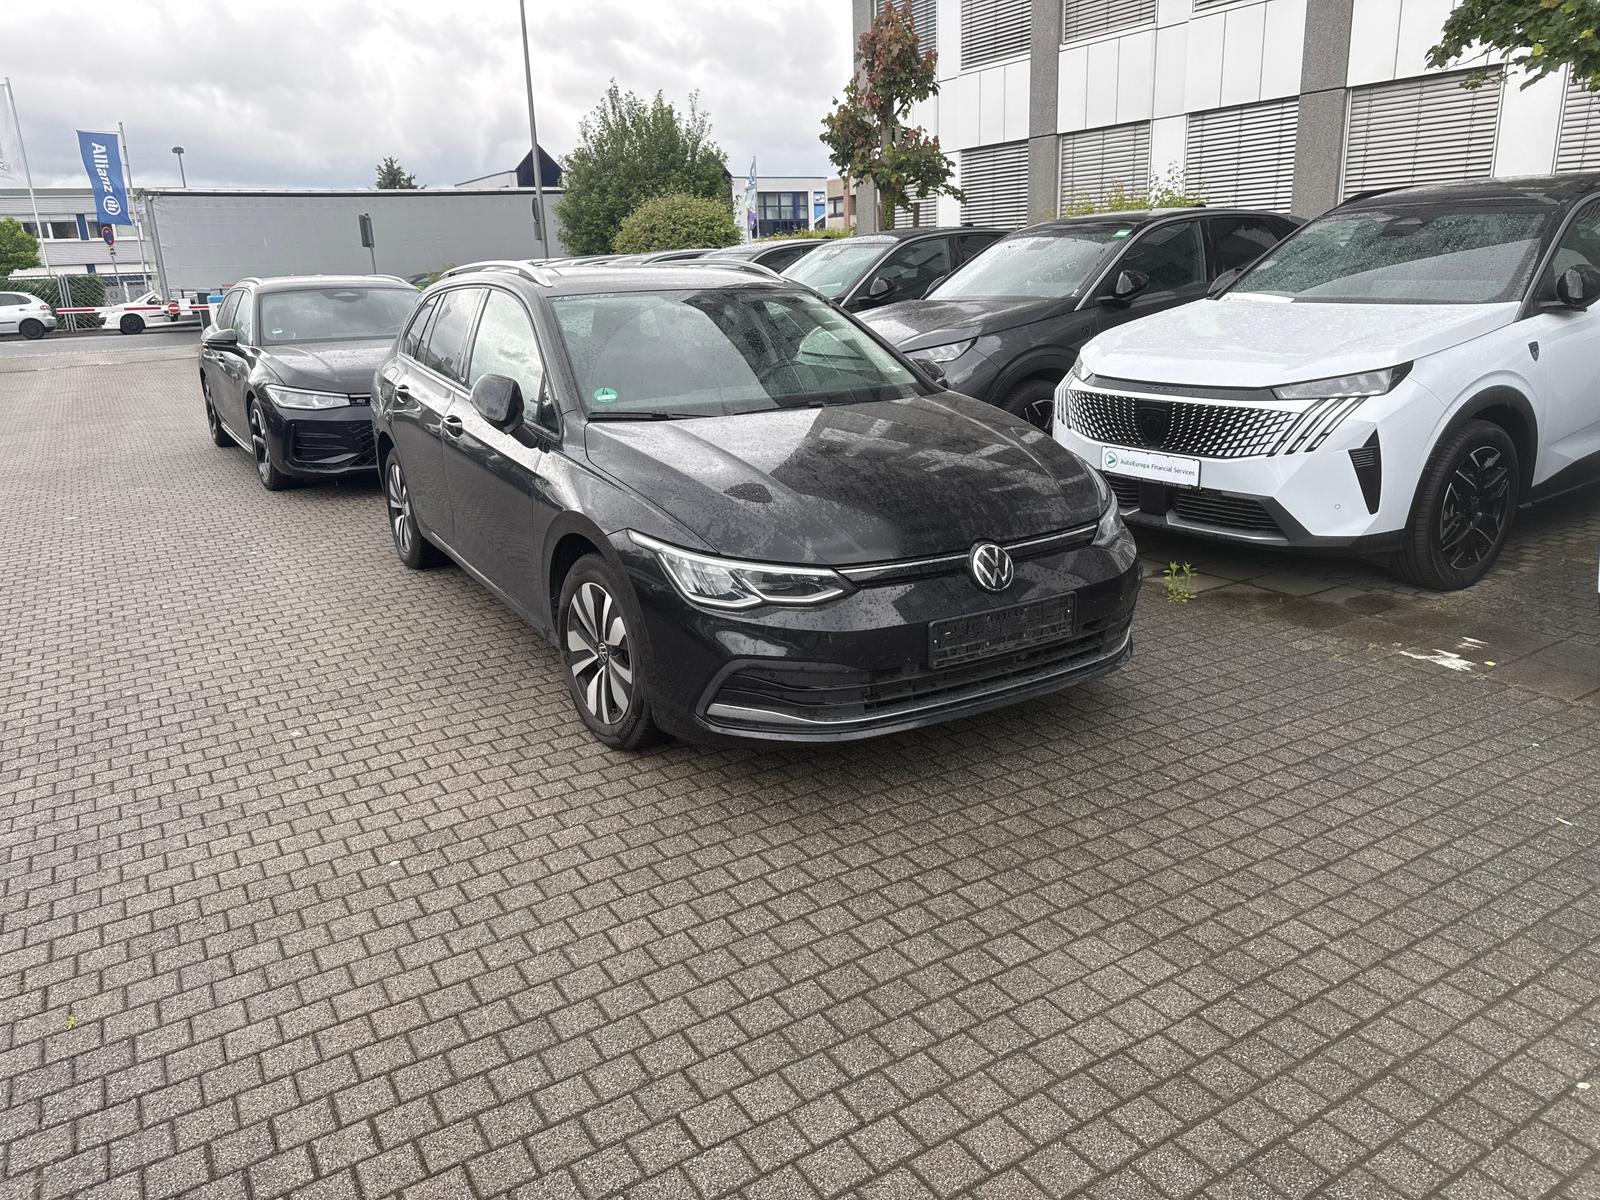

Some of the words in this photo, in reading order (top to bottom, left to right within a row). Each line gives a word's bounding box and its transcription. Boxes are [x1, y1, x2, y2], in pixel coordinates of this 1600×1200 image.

[91, 142, 114, 193] Allianz
[1120, 458, 1150, 470] AutoEuropa
[1151, 463, 1173, 473] Financial
[1173, 467, 1196, 477] Services
